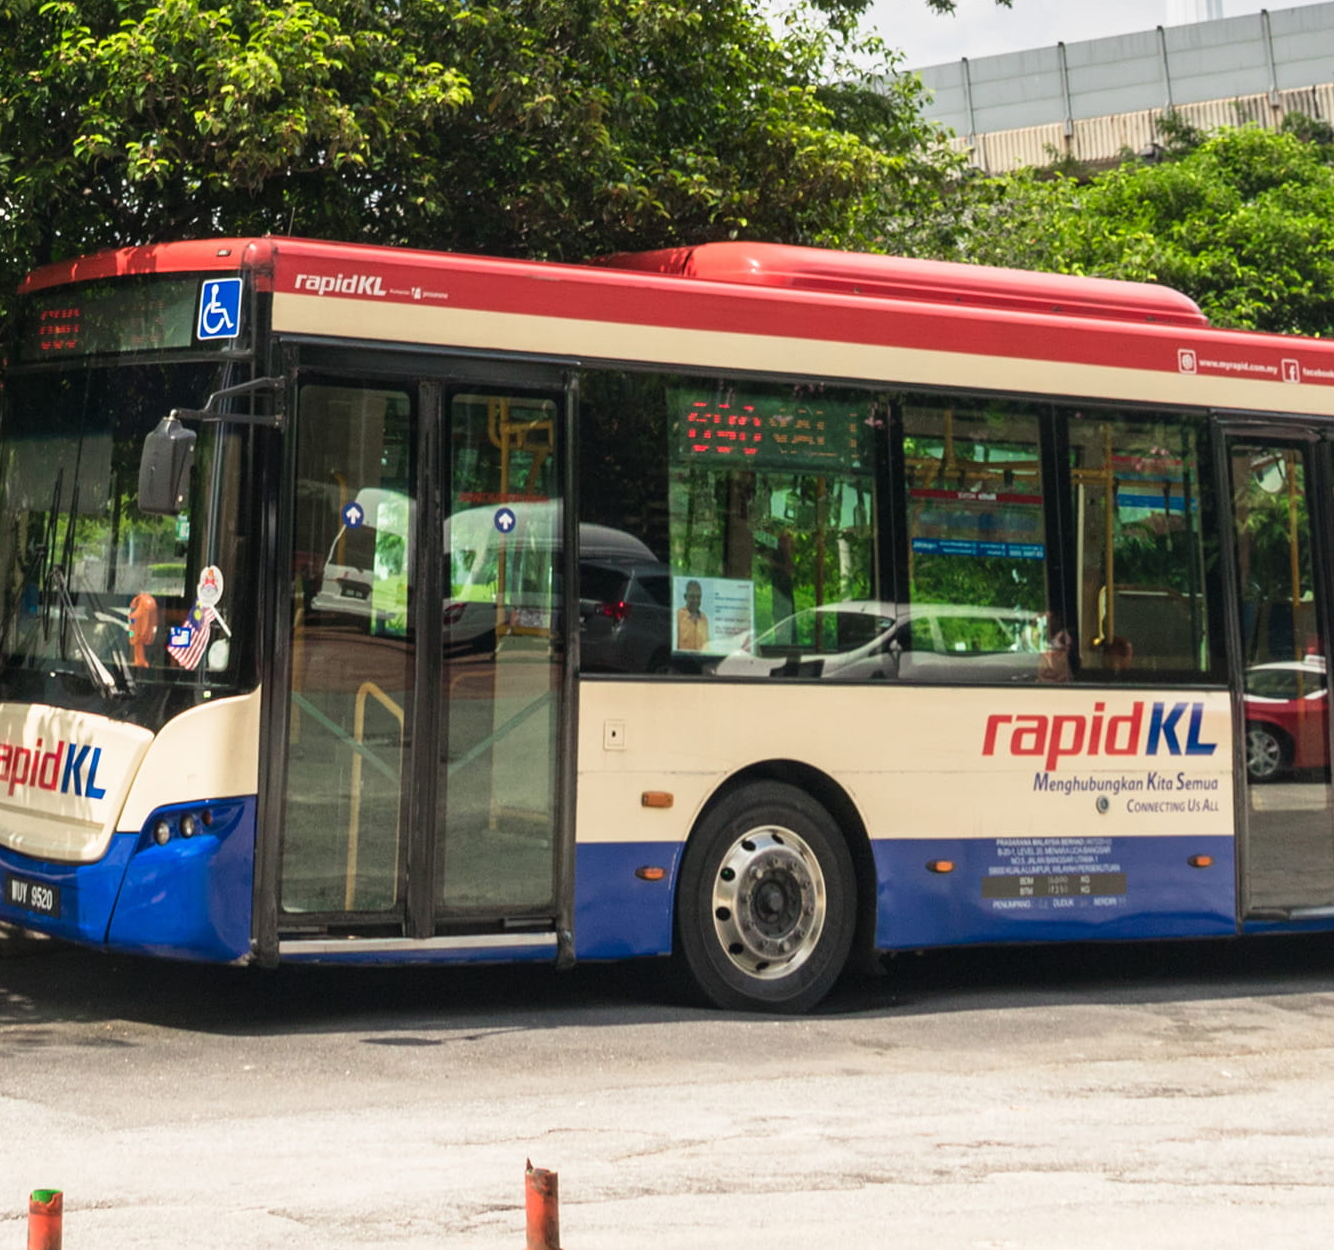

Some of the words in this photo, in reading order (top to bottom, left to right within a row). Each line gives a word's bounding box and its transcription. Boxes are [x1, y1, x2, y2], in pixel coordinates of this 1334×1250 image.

[294, 274, 386, 296] rapidKL
[981, 701, 1218, 772] rapidKL
[1033, 773, 1144, 796] Menghubungkan
[1147, 772, 1173, 791] Kita
[1176, 773, 1219, 791] Semua
[11, 880, 28, 903] WUY
[31, 885, 53, 911] 9520
